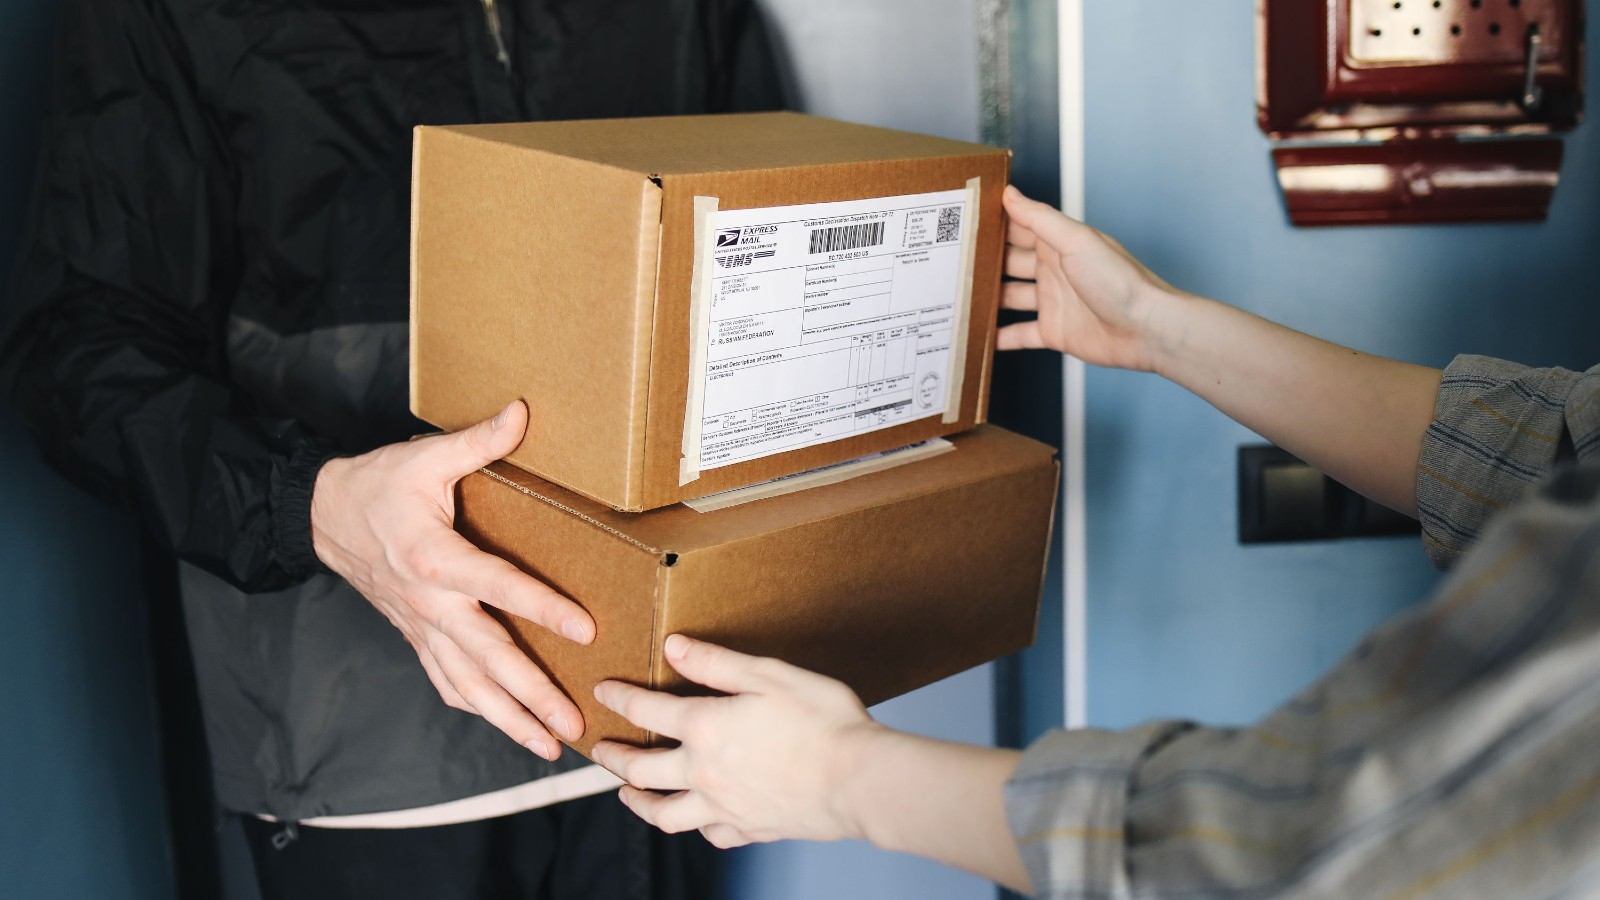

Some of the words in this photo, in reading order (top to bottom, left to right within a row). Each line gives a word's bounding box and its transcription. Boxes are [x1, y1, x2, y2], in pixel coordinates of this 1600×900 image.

[743, 225, 778, 235] EXPRESS
[718, 336, 741, 344] RUSSIAN
[742, 330, 774, 341] FEDERATION
